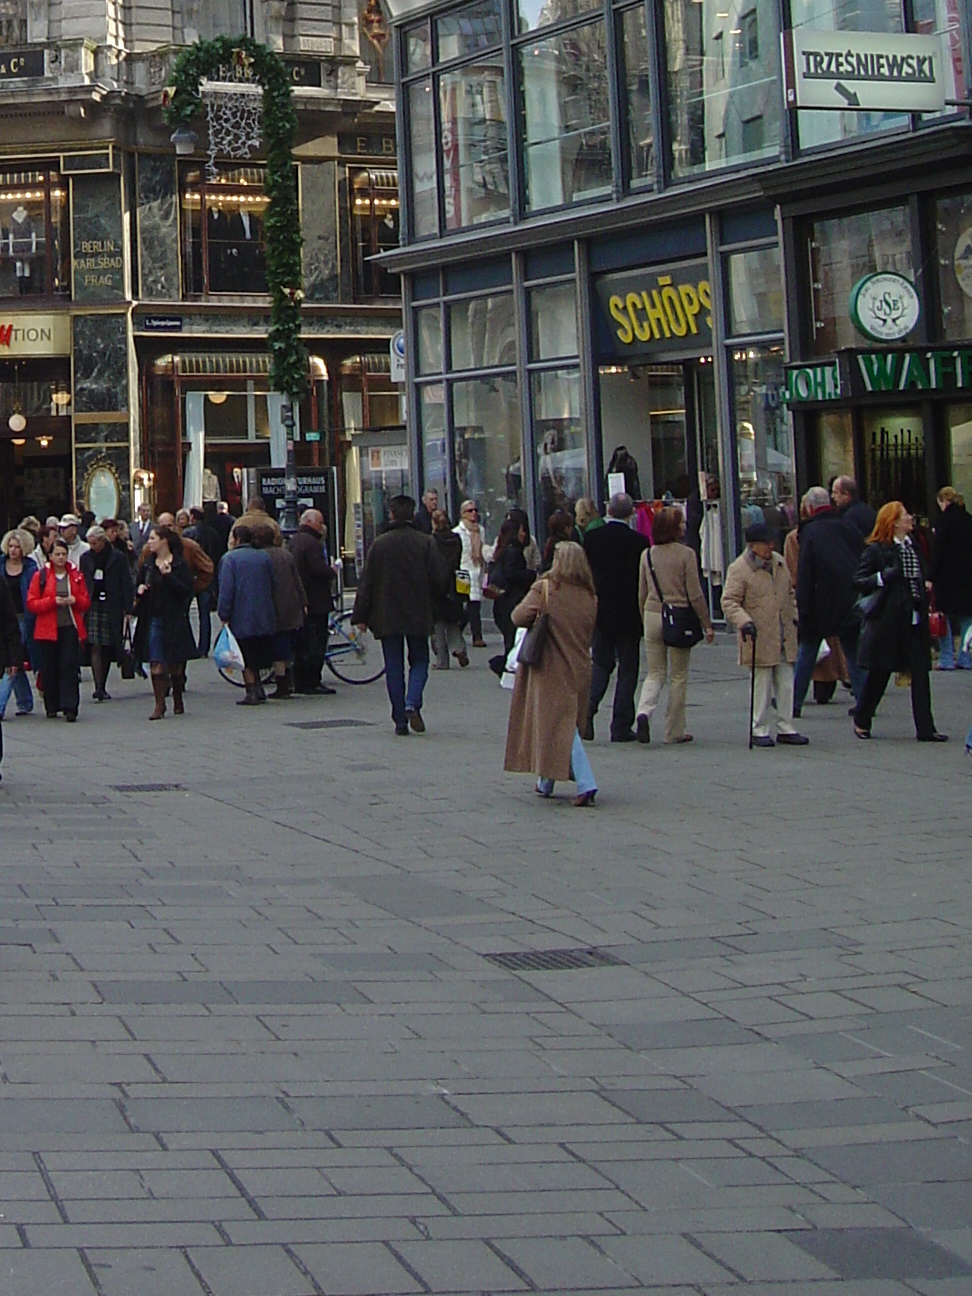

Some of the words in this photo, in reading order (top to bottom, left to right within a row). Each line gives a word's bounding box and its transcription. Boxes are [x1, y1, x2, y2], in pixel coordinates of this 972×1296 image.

[81, 240, 114, 253] BERLIN
[73, 257, 123, 270] KARLSBAD
[85, 274, 113, 286] PRAG
